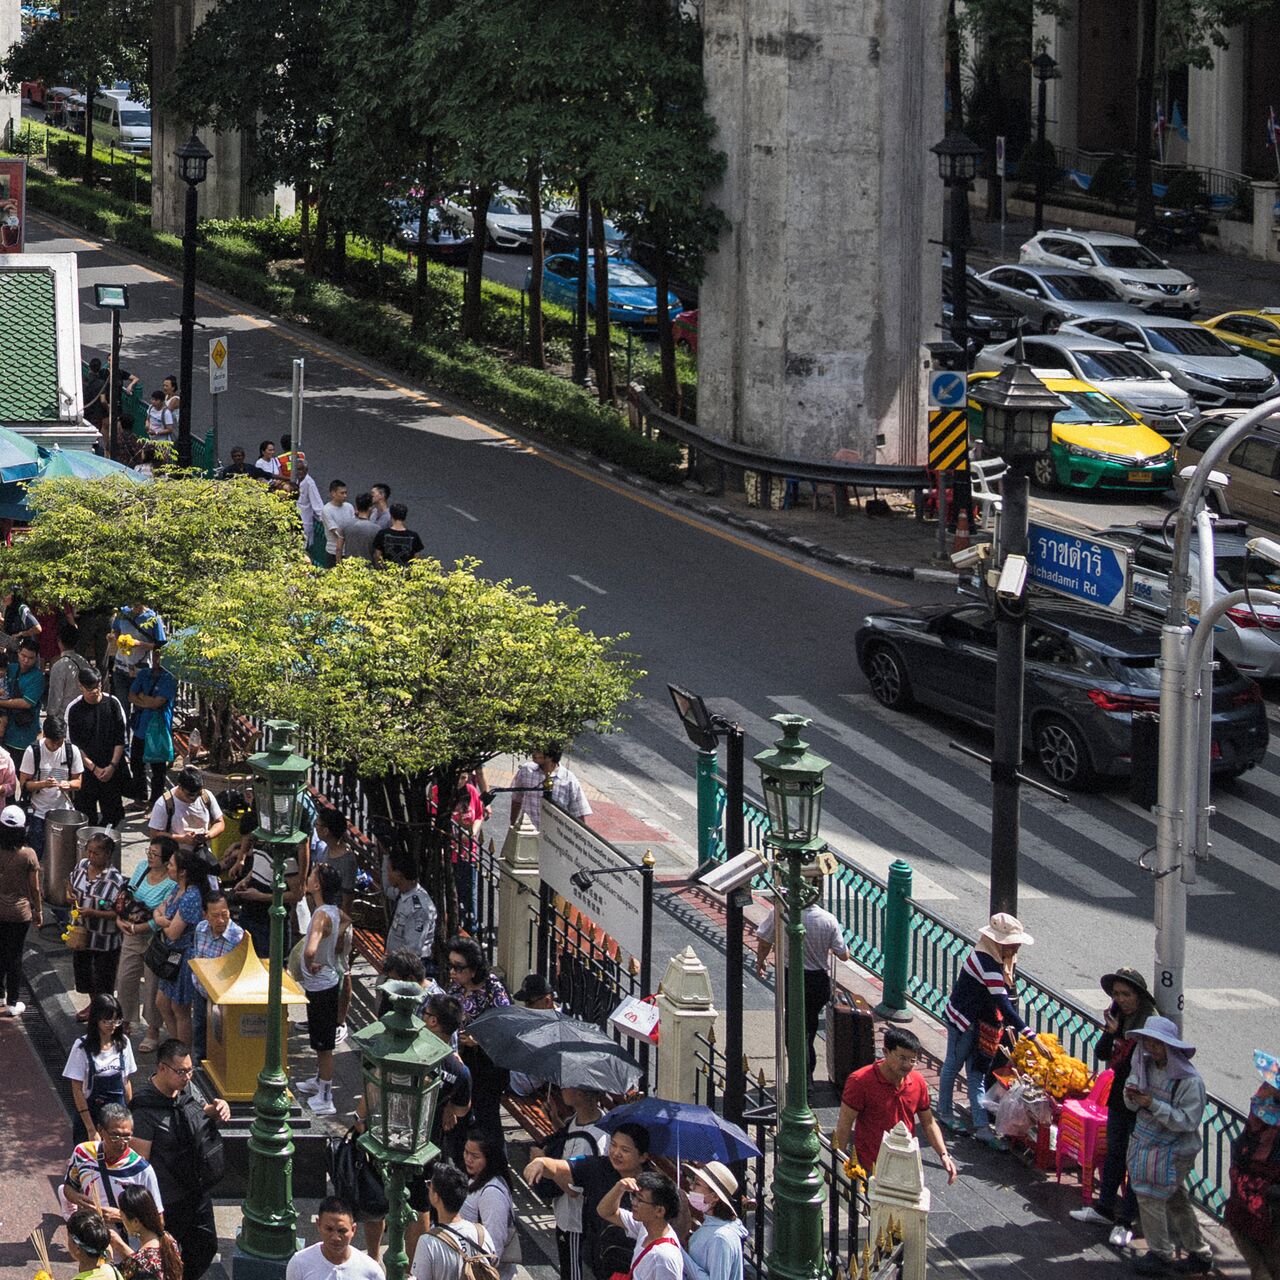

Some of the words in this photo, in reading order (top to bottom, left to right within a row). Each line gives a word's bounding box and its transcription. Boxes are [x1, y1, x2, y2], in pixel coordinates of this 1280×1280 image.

[1038, 536, 1102, 577] ราชดำริ
[1030, 564, 1079, 590] tchadamri
[1083, 581, 1100, 597] Rd.
[1161, 970, 1173, 988] 8
[1177, 994, 1184, 1011] 8
